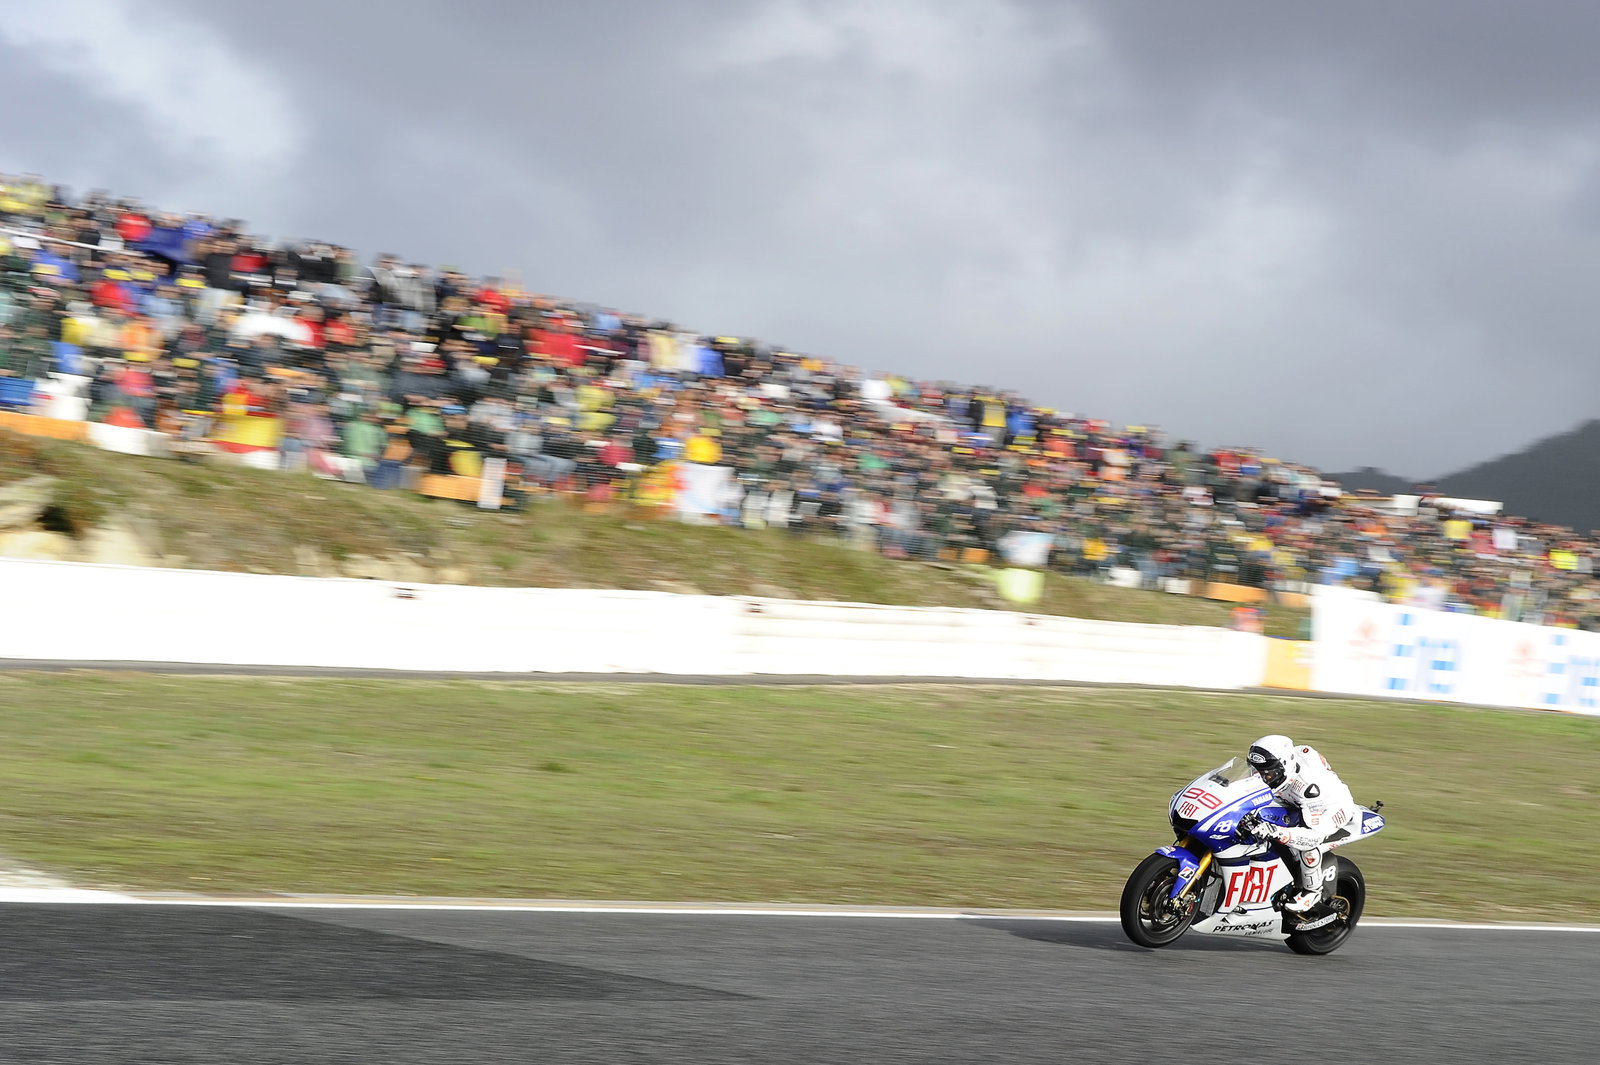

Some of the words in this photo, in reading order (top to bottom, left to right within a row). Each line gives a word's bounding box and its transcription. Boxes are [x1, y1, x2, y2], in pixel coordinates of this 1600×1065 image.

[1182, 787, 1223, 810] 99
[1178, 801, 1200, 818] FIAT
[1331, 808, 1347, 826] FIAT
[1224, 864, 1278, 908] FIAT
[1212, 919, 1275, 933] PETRONAS
